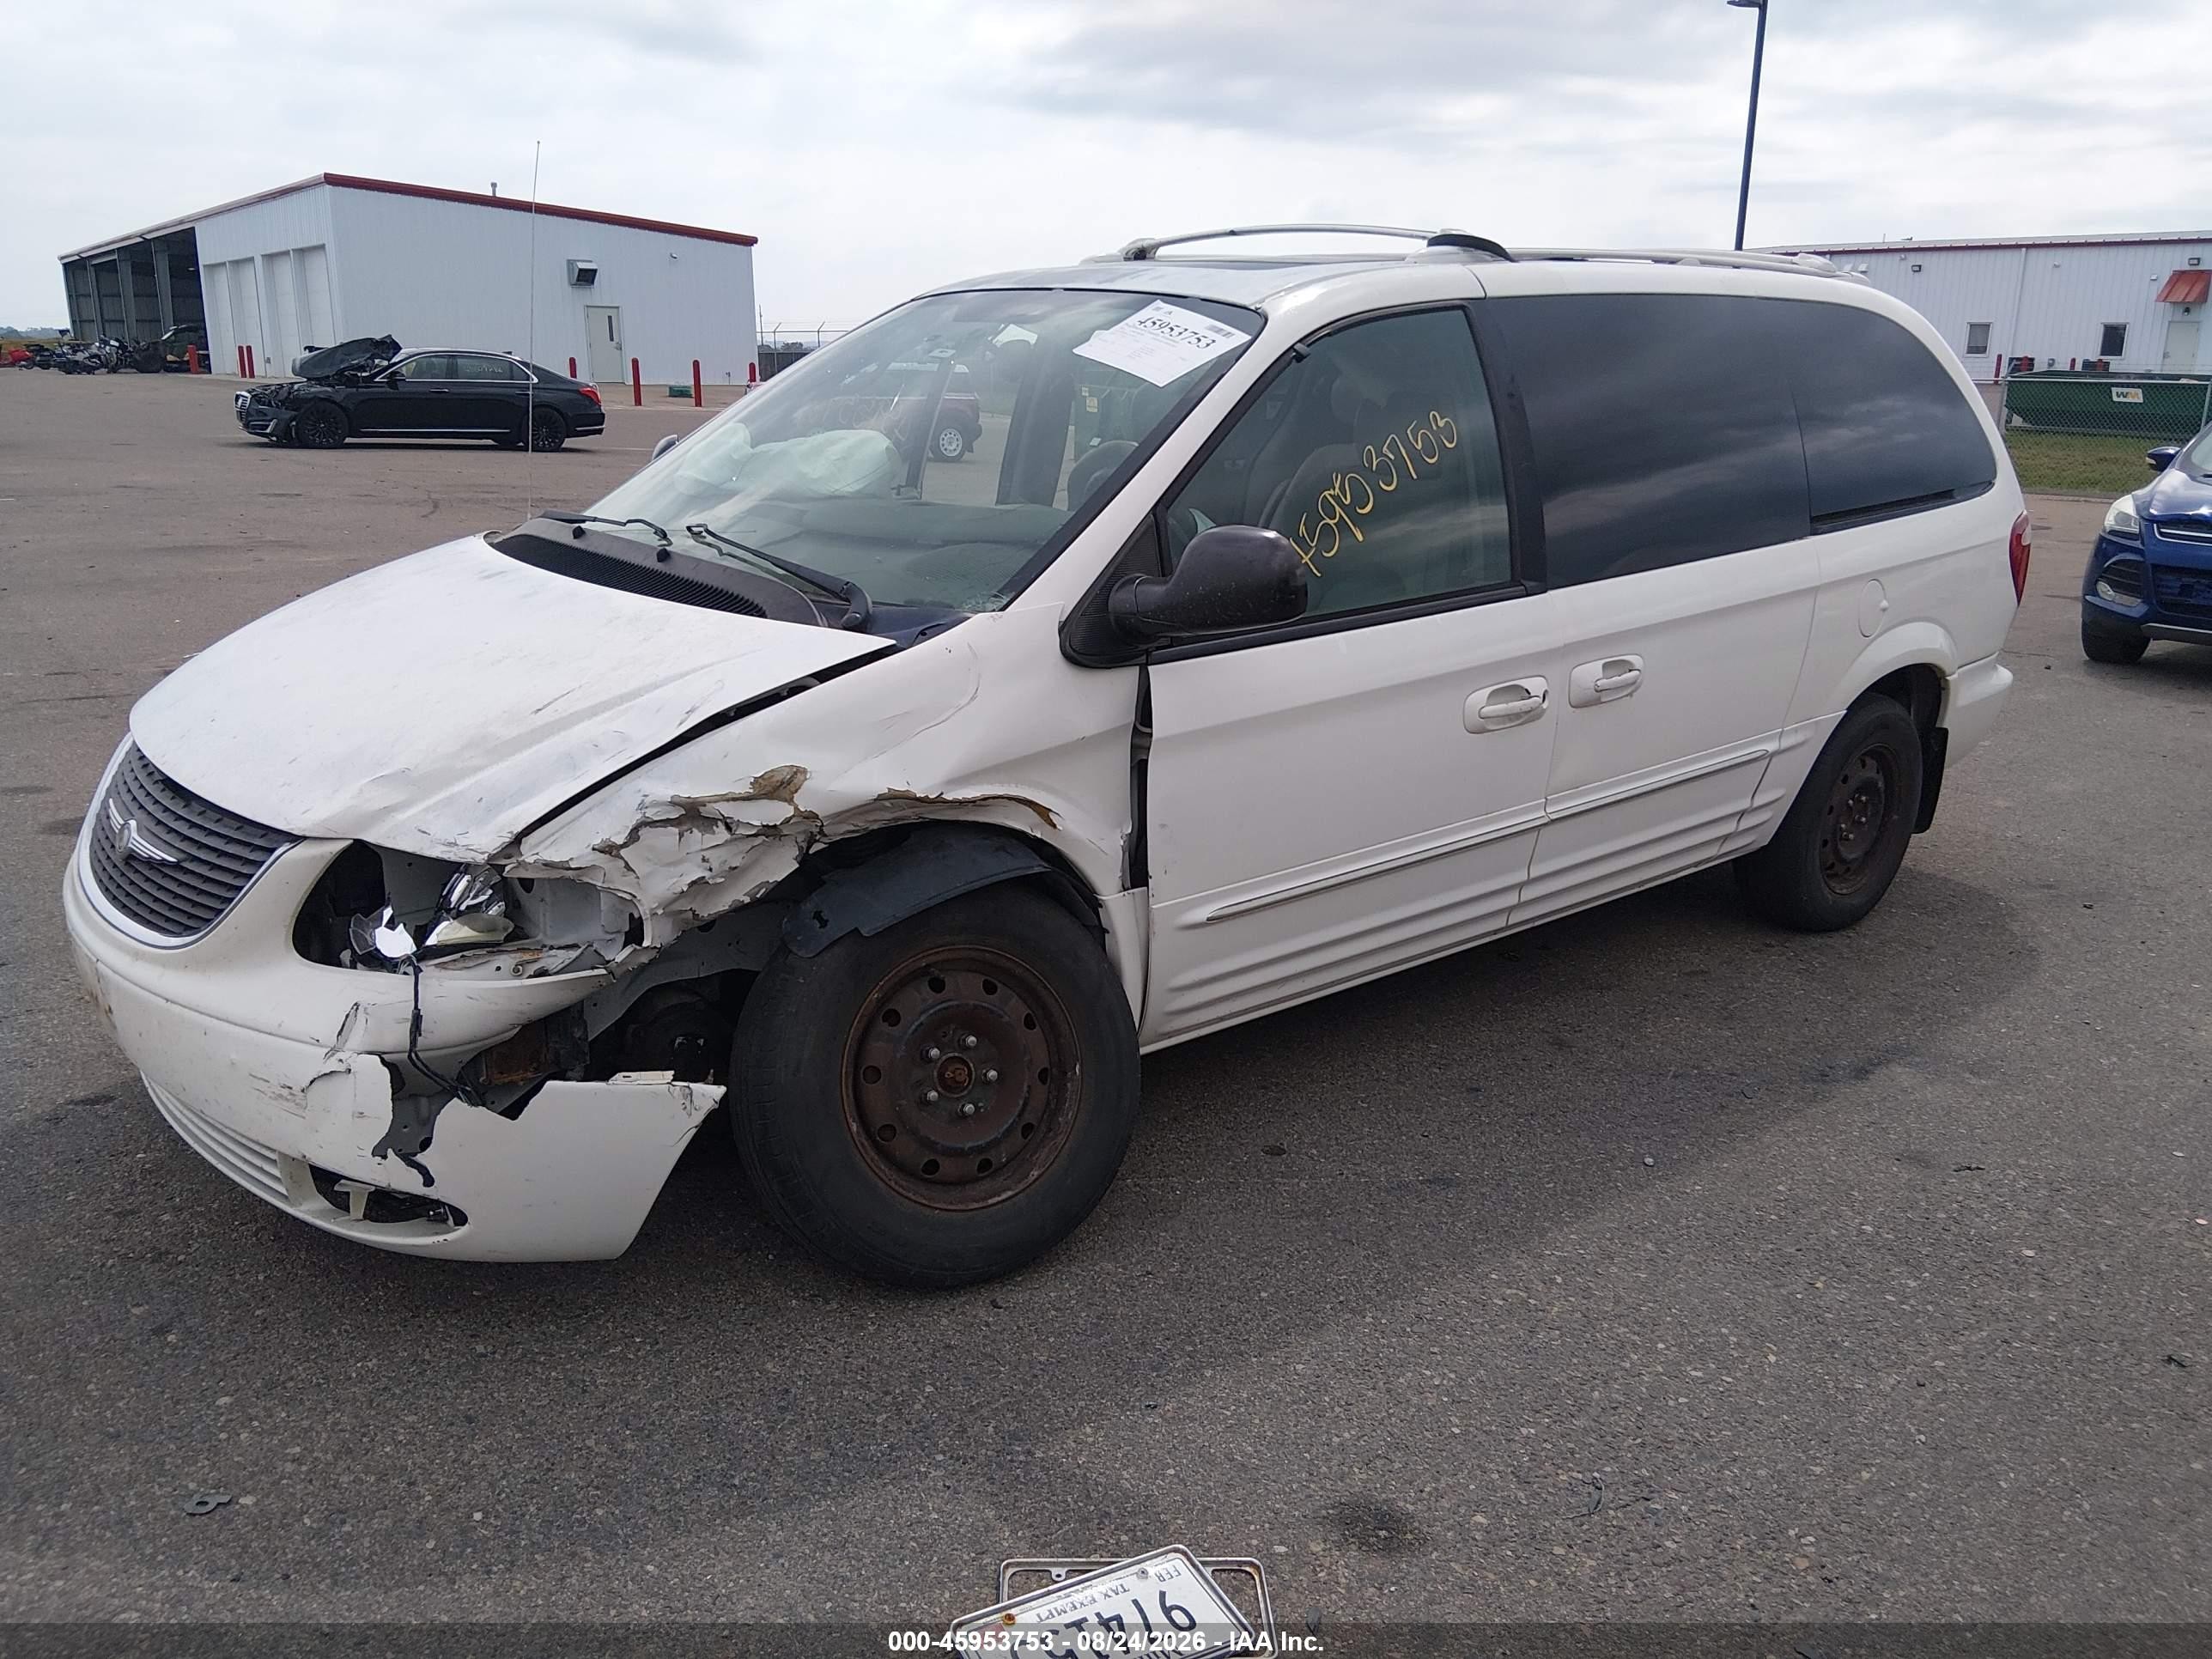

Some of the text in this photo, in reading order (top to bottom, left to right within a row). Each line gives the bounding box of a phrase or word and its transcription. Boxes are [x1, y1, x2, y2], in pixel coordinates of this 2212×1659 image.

[1137, 316, 1216, 349] 45953753
[1288, 410, 1458, 577] 45953753
[1103, 1583, 1131, 1600] TAX
[1036, 1597, 1100, 1623] EXEMPT
